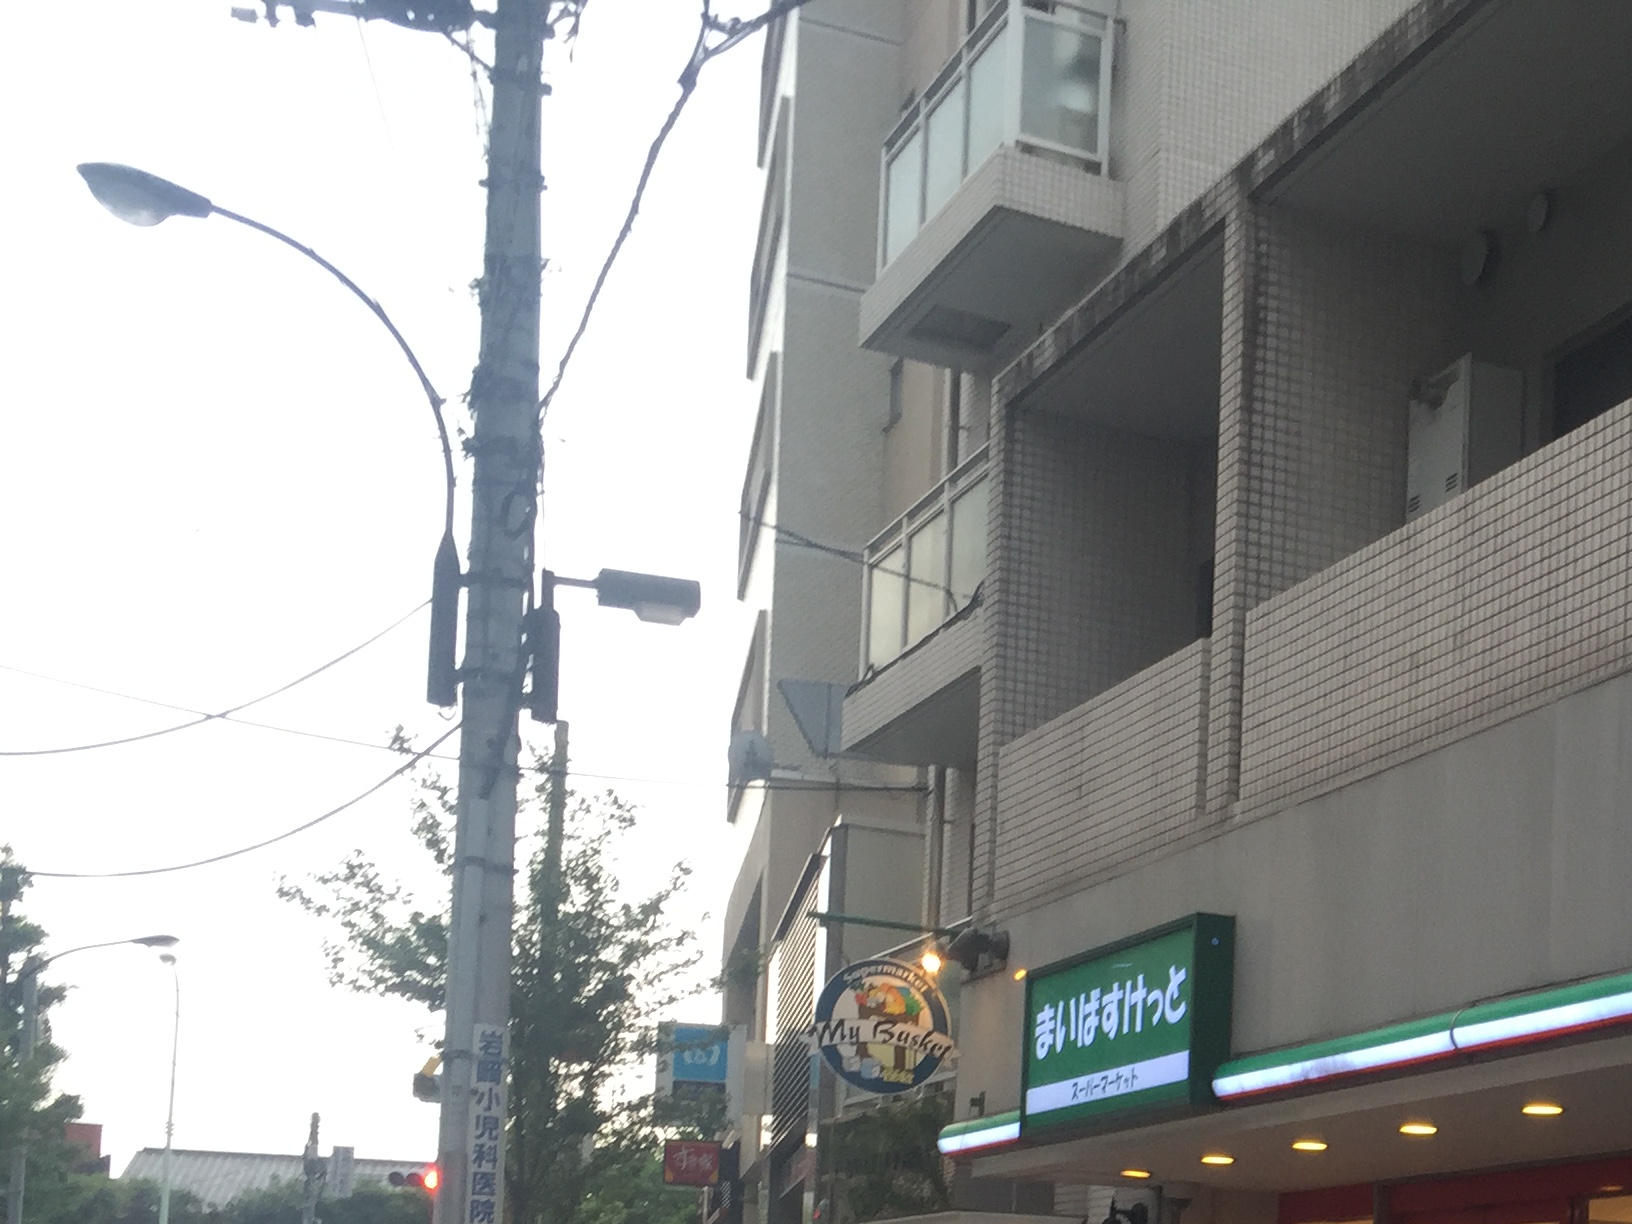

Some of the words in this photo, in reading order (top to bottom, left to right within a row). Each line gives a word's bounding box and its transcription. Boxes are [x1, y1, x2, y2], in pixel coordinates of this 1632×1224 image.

[843, 964, 930, 993] Supermarket
[1034, 964, 1187, 1060] まいばすけっと
[806, 1018, 861, 1048] My
[872, 1018, 953, 1060] Basket
[1071, 1067, 1139, 1101] スーパーマーケット
